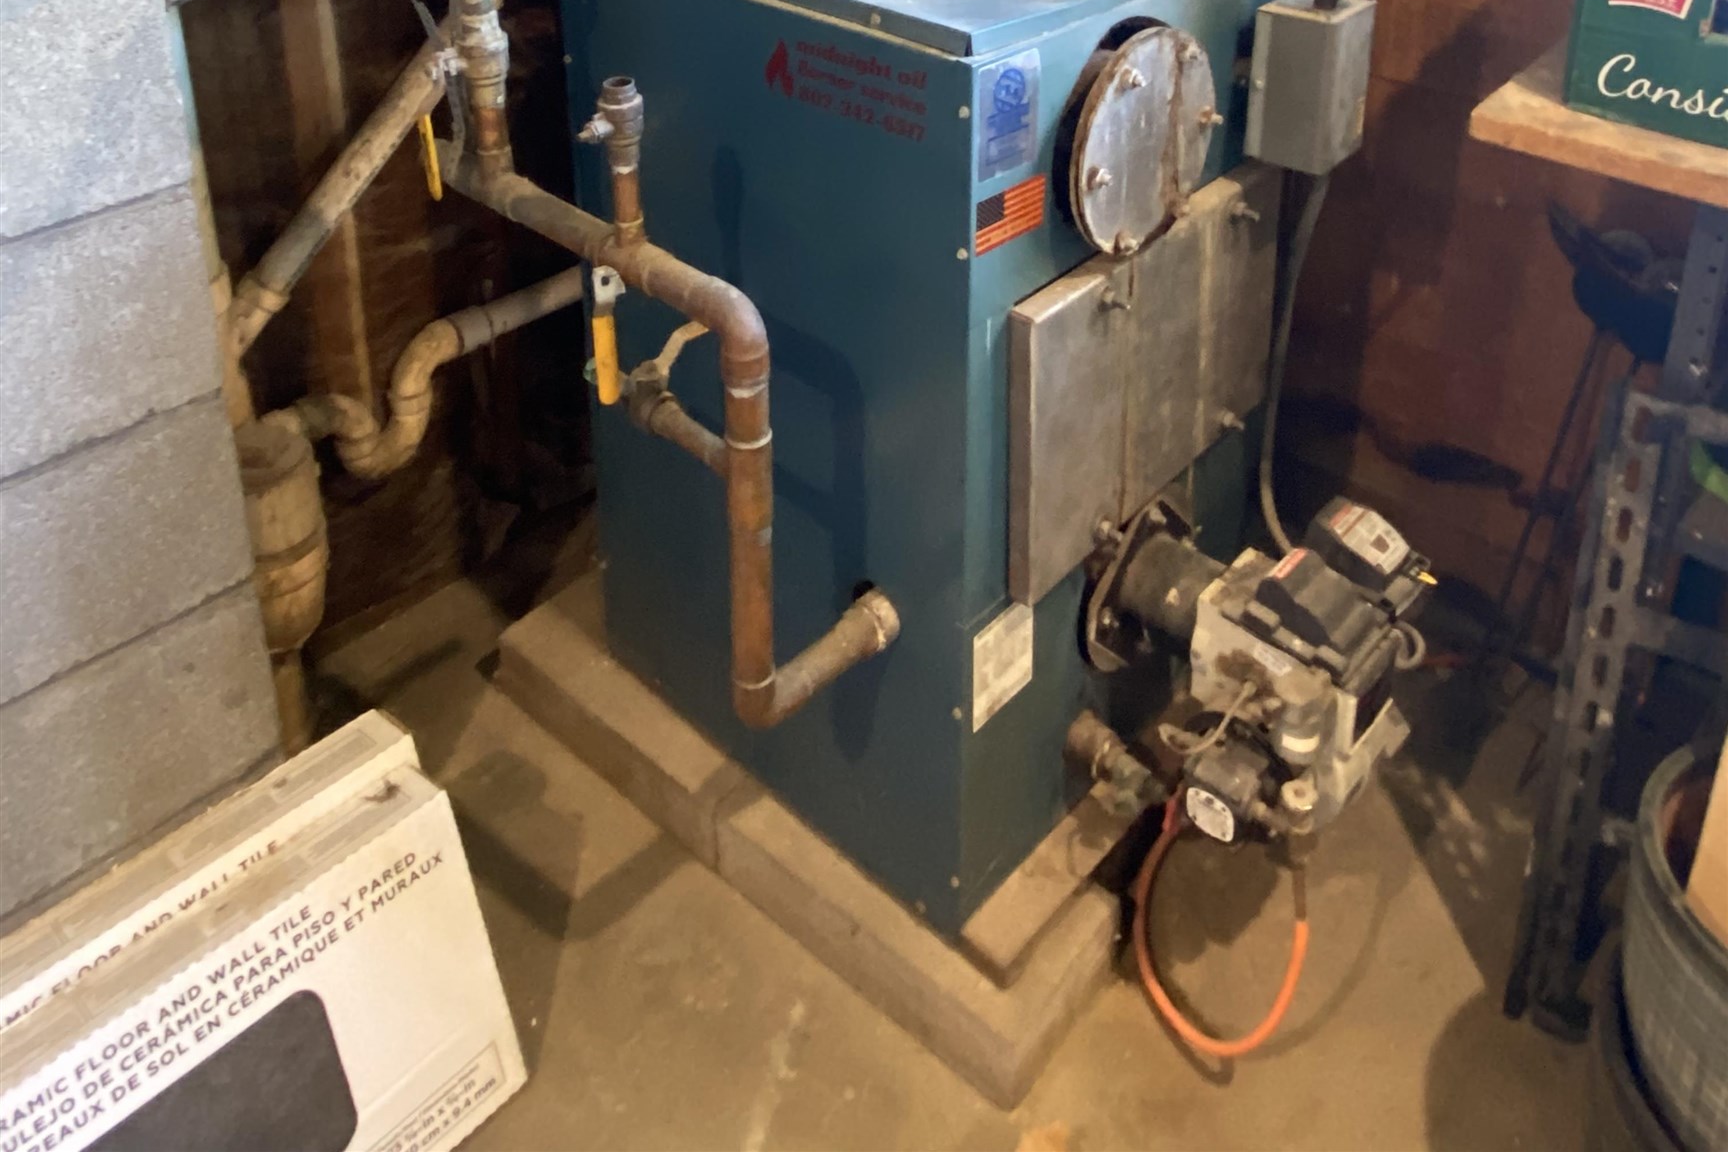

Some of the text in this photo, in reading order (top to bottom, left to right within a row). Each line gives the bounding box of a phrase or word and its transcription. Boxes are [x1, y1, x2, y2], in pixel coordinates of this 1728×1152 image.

[74, 1020, 151, 1082] FLOOR
[158, 984, 202, 1024] AND
[207, 940, 266, 986] WALL
[269, 905, 312, 942] TILE
[83, 1068, 114, 1100] DE
[119, 989, 228, 1073] CERÁMICA
[233, 946, 288, 992] PARA
[292, 910, 336, 948] PISO
[341, 898, 352, 912] Y
[358, 851, 416, 901] PARED
[110, 1073, 141, 1103] DE
[146, 1041, 189, 1079] SOL
[194, 1014, 222, 1043] EN
[227, 928, 340, 1017] CÉRAMIQUE
[344, 908, 365, 933] ET
[370, 851, 443, 913] MURAUX
[131, 911, 174, 943] AND
